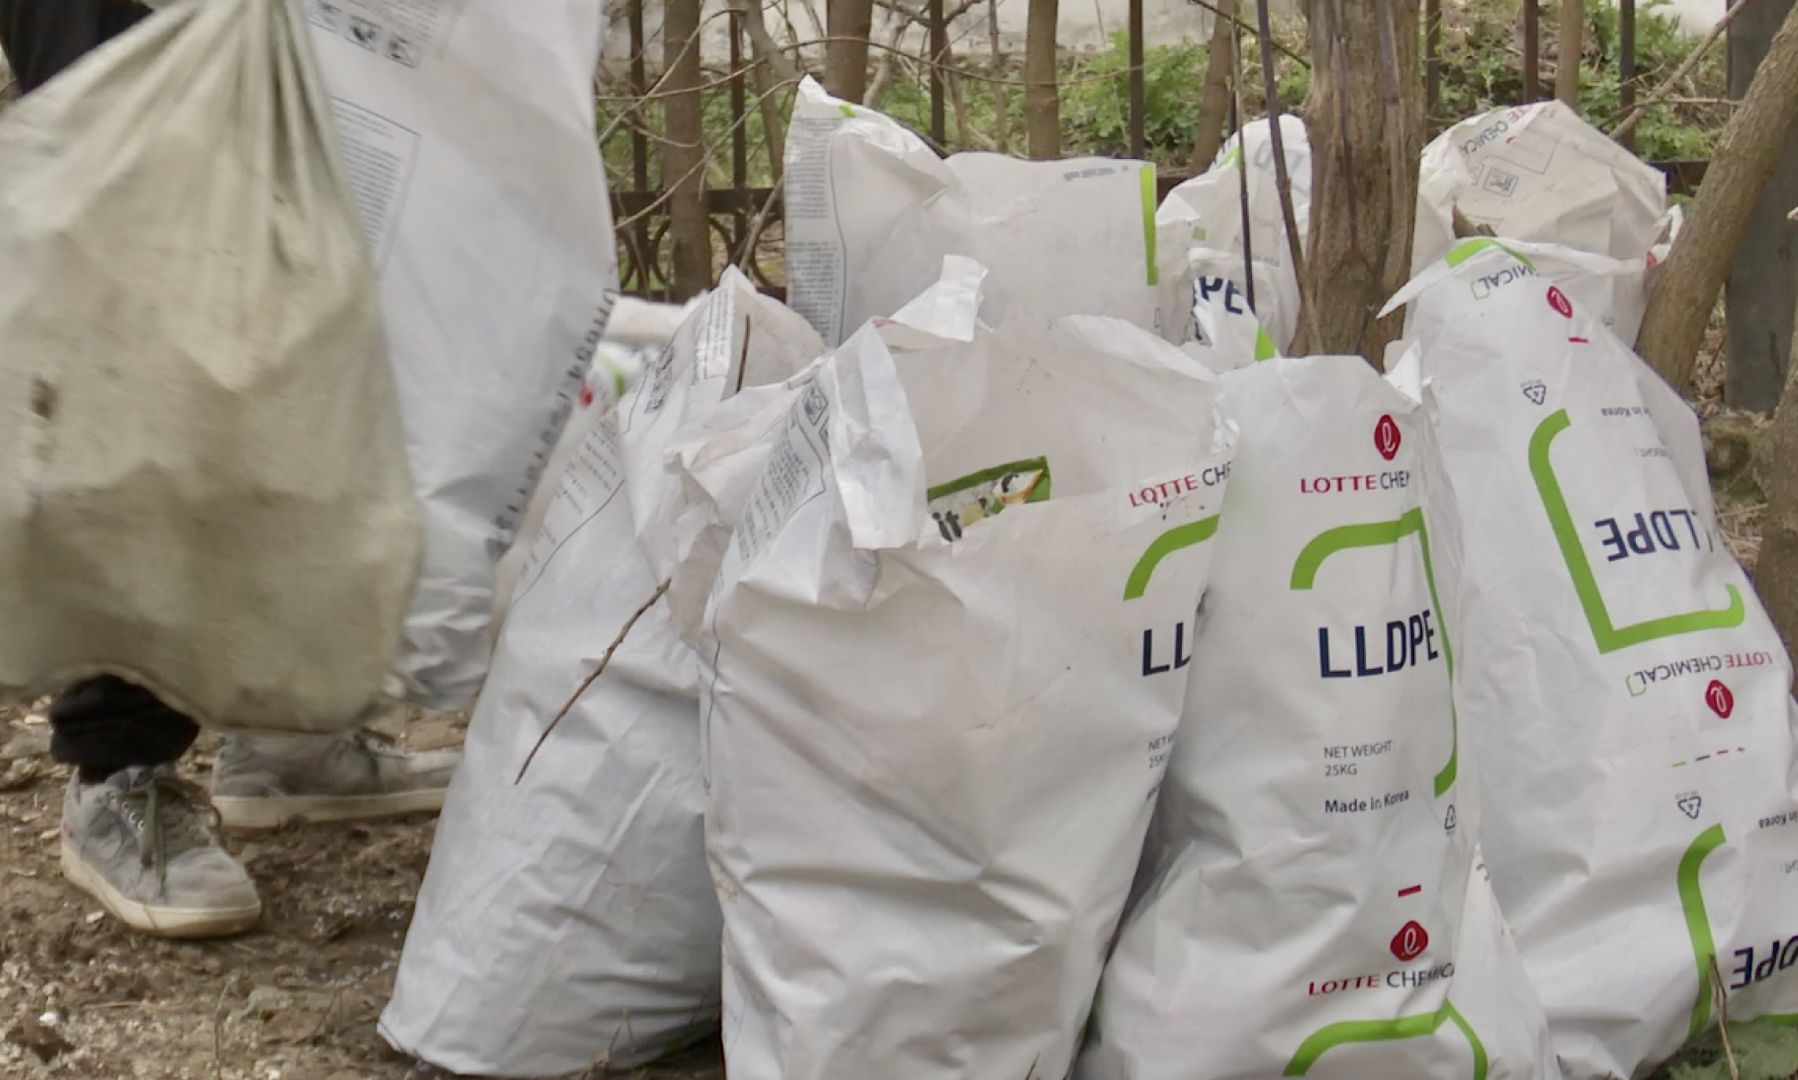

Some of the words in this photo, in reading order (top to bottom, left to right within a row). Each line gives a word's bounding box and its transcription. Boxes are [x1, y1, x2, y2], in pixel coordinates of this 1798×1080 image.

[1129, 474, 1199, 507] LOTTE
[1300, 475, 1377, 494] LOTTE
[1318, 610, 1438, 678] LLDPE
[1633, 655, 1722, 685] CHEMICAL
[1324, 746, 1348, 758] NET
[1325, 763, 1357, 777] 25KG
[1325, 798, 1367, 813] Made
[1370, 796, 1382, 810] in
[1384, 790, 1410, 807] Korea
[1758, 814, 1787, 829] Korea
[1308, 974, 1380, 996] LOTTE
